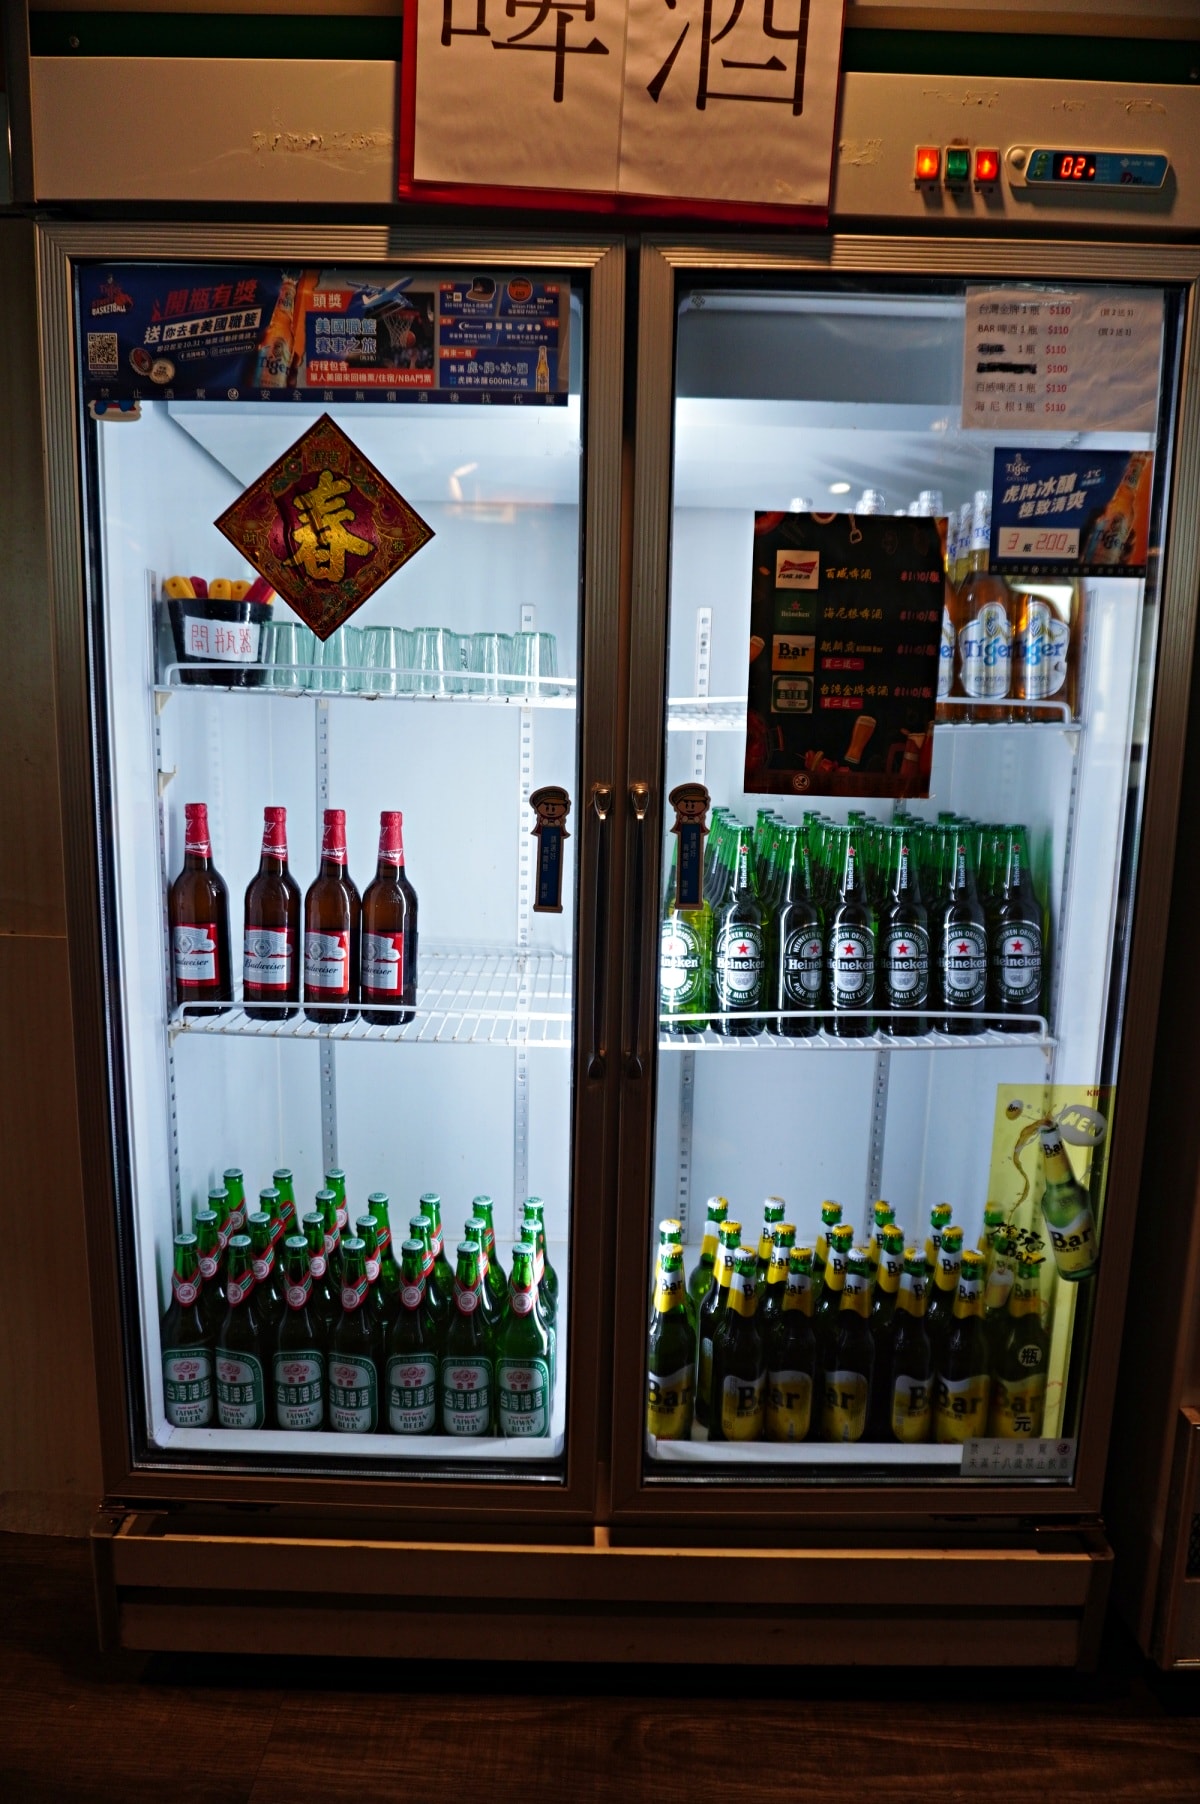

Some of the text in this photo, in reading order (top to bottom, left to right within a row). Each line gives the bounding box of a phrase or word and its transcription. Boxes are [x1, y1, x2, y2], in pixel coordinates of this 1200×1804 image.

[164, 278, 258, 317] 開瓶有獎
[313, 293, 342, 309] 頭獎
[1050, 304, 1071, 315] $110
[315, 318, 377, 335] 美國職籃
[978, 325, 995, 333] BAR
[1048, 325, 1069, 335] $110
[144, 325, 161, 344] 送
[315, 337, 377, 354] 賽事之旅
[1046, 344, 1067, 354] $110
[310, 361, 349, 372] 行程包含
[1047, 364, 1068, 374] $100
[1046, 383, 1067, 394] $110
[1045, 402, 1066, 412] $110
[1005, 463, 1031, 476] Tiger
[1002, 473, 1078, 504] 虎牌冰釀
[1018, 491, 1087, 519] 極致清爽
[1008, 533, 1020, 550] 3
[1035, 533, 1068, 550] 200
[1067, 545, 1076, 554] 元
[824, 567, 872, 581] 百威啤酒
[823, 605, 884, 621] 海尼根啤酒
[191, 624, 252, 655] 開瓶器
[778, 643, 809, 657] Bar
[964, 636, 1012, 667] Tiger
[740, 855, 748, 888] Heineken
[900, 856, 908, 889] Heineken
[244, 958, 286, 971] Budweiser
[716, 957, 765, 970] Heineken
[840, 992, 855, 1000] MALT
[1008, 988, 1024, 996] MALT
[1050, 1228, 1092, 1248] Bar
[833, 1258, 848, 1272] Ba
[887, 1261, 904, 1275] Ba
[959, 1285, 983, 1300] Bar
[1020, 1348, 1040, 1365] 瓶
[1014, 1416, 1031, 1432] 元
